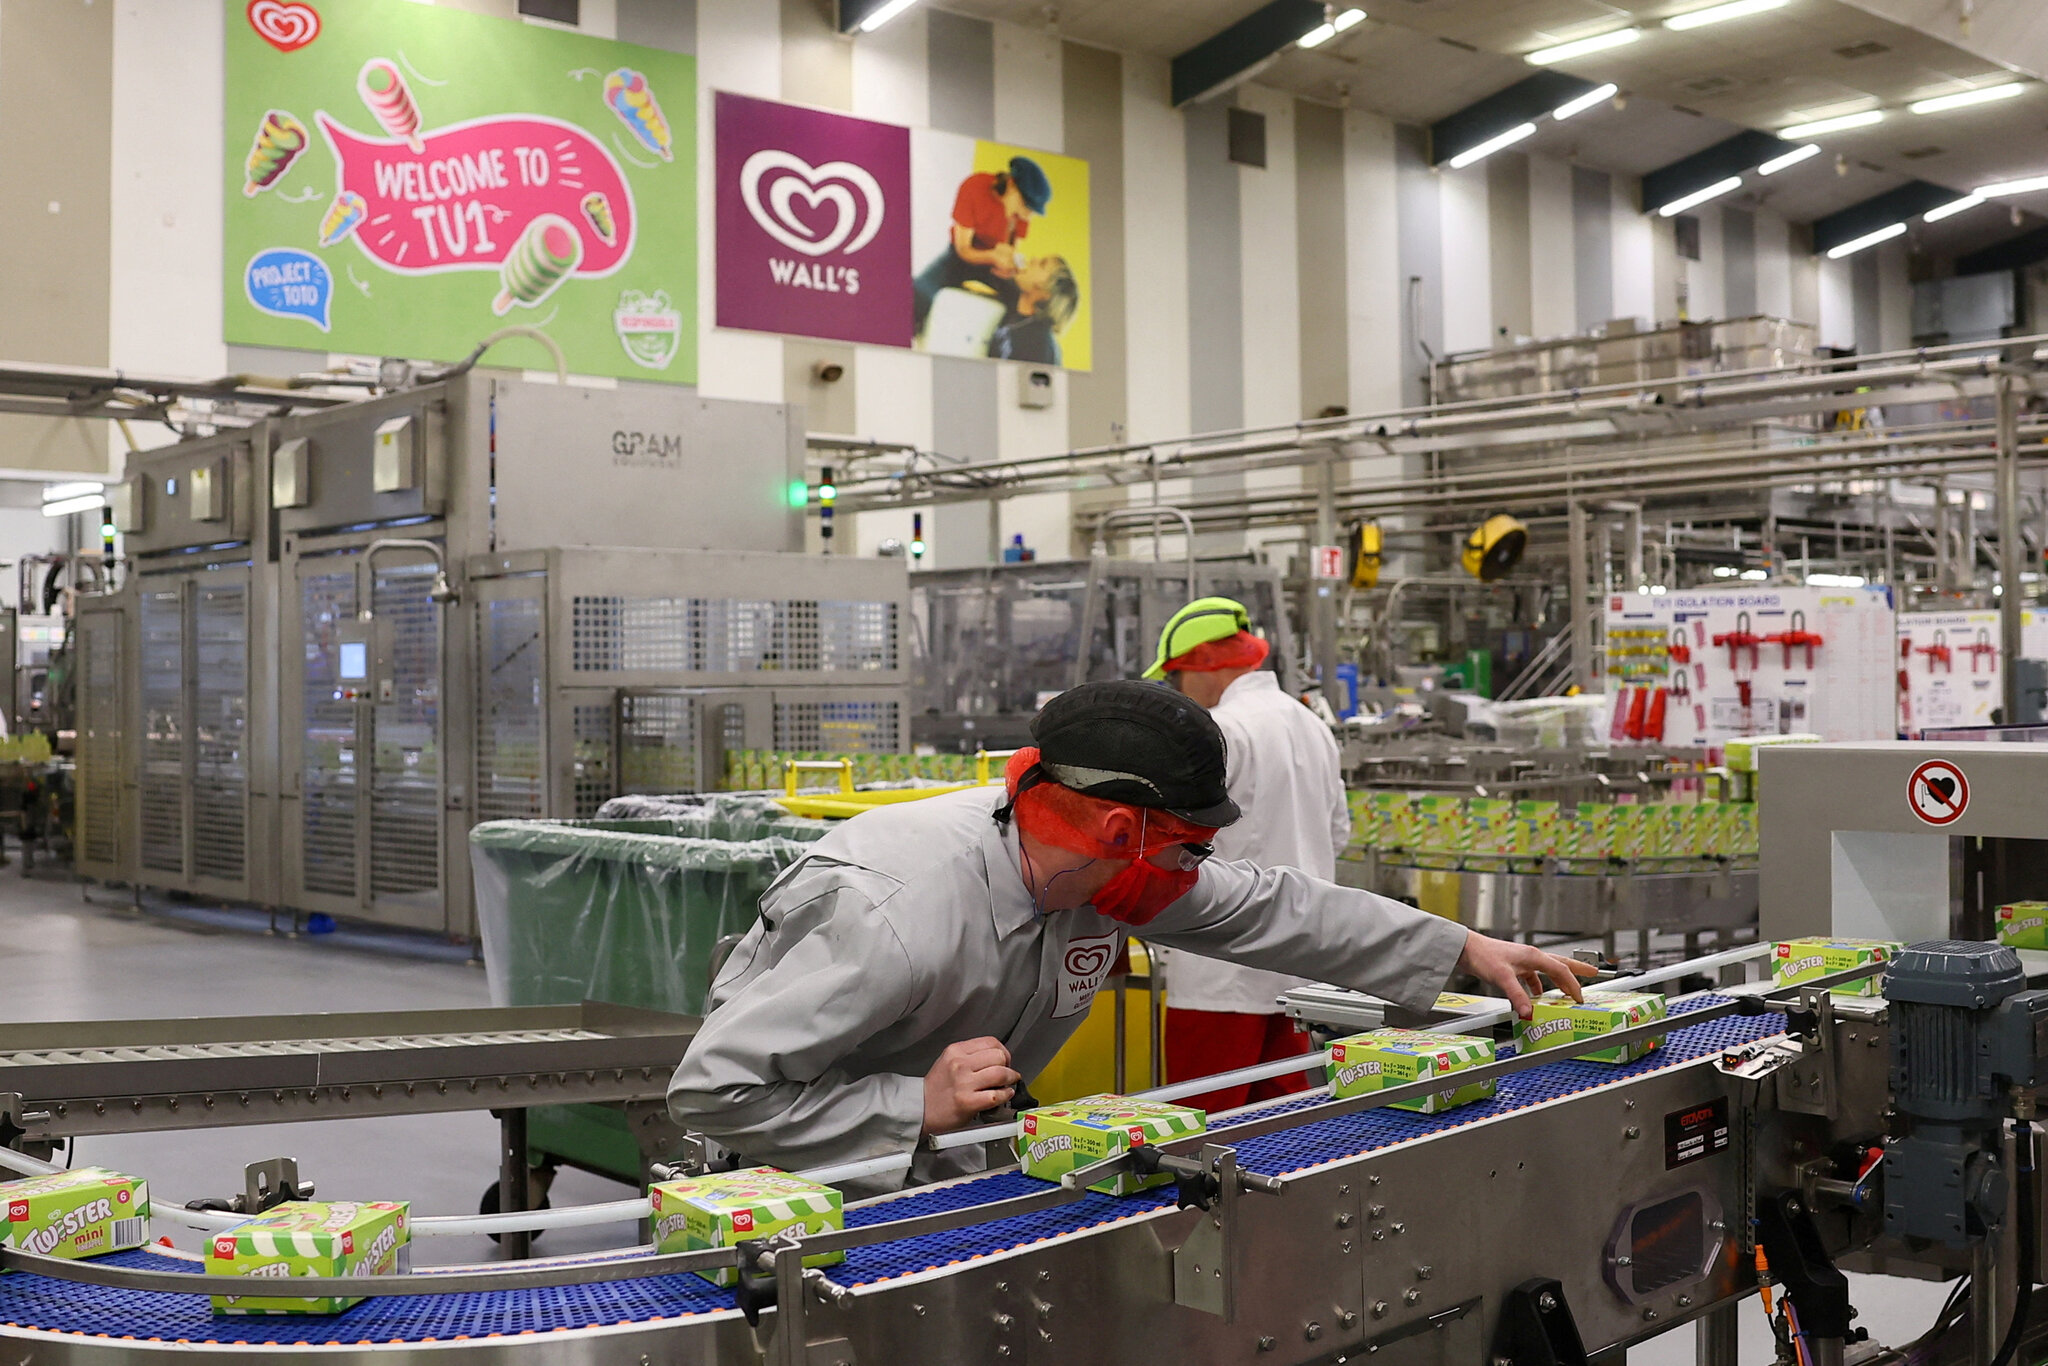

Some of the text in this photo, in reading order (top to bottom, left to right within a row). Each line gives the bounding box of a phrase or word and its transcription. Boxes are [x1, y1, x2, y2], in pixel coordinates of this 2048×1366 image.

[374, 146, 549, 201] WELCOME TO
[412, 200, 496, 259] TU1
[252, 261, 311, 289] PROJECT
[768, 257, 860, 294] WALL'S
[282, 284, 318, 306] TOTO
[1675, 597, 1734, 607] ISOLATION
[1738, 595, 1780, 606] BOARD
[120, 1191, 127, 1201] 6
[74, 1226, 103, 1245] mini
